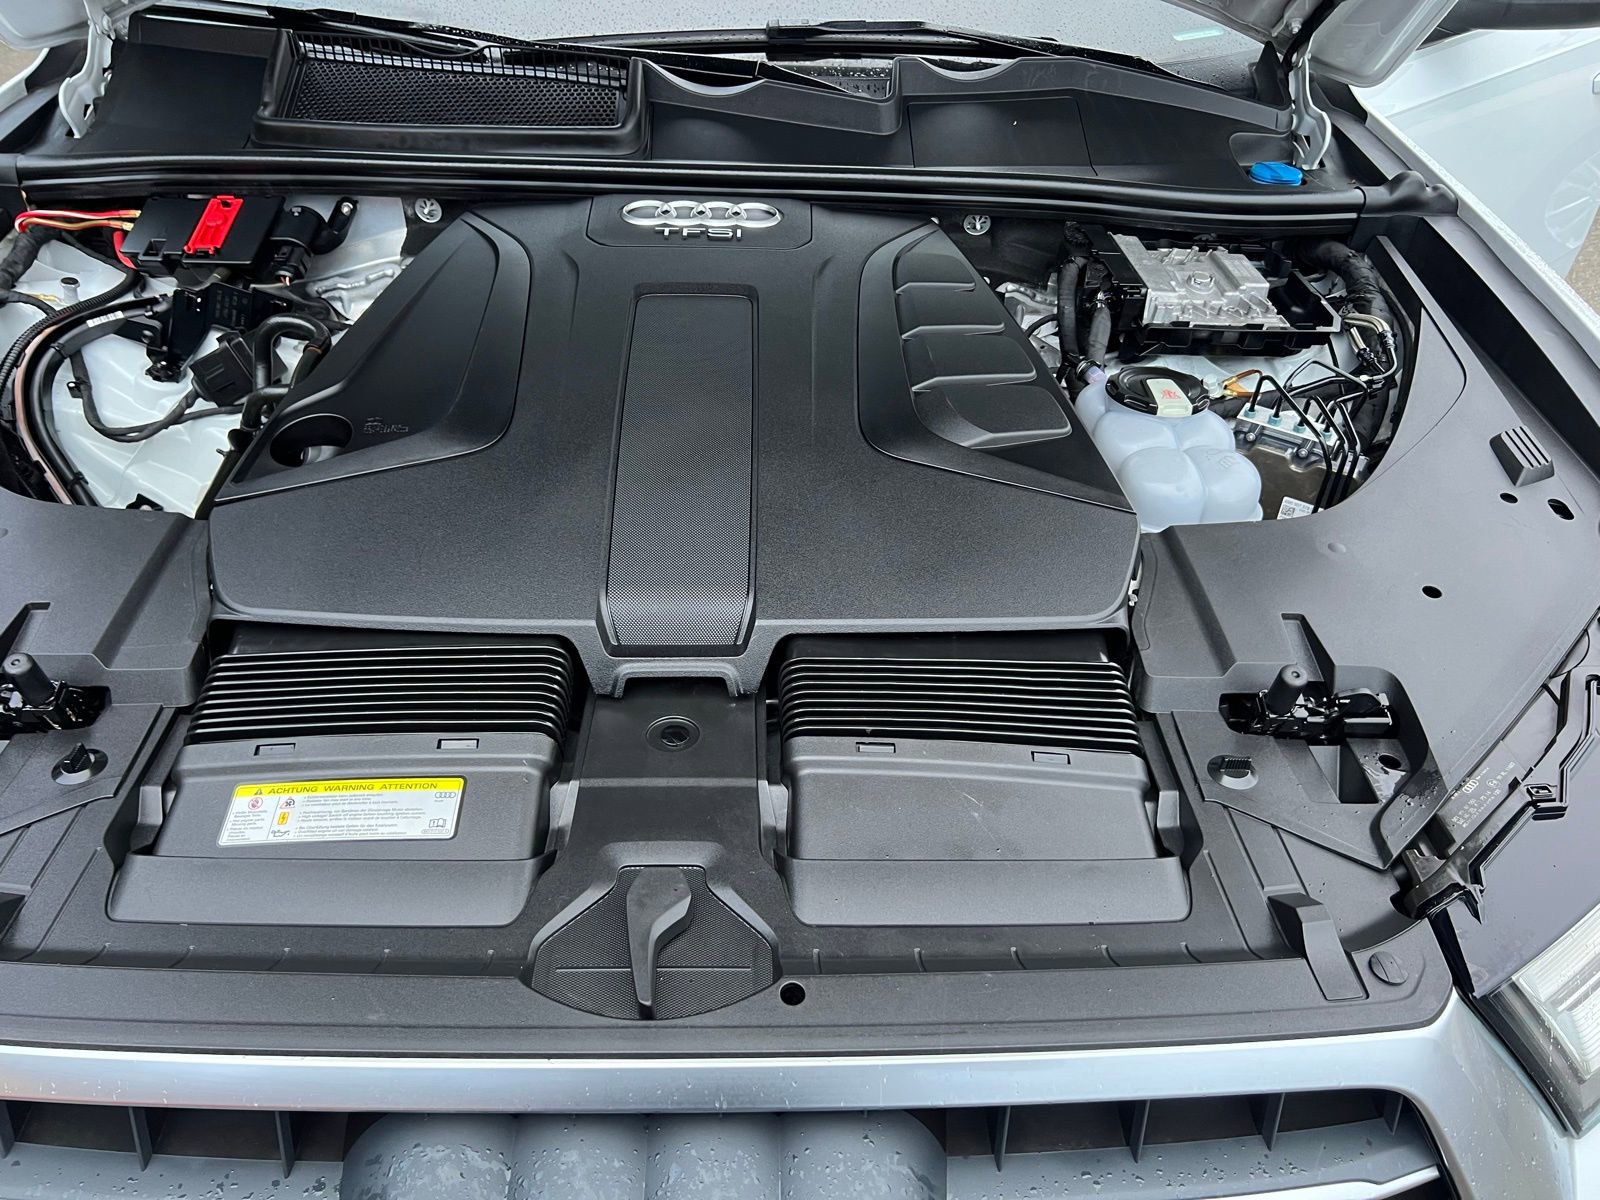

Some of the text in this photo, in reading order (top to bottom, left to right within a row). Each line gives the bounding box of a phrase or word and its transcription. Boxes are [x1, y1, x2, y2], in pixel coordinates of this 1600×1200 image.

[654, 227, 743, 241] TFSI
[269, 783, 438, 795] ACHTUNG WARNING ATTENTION
